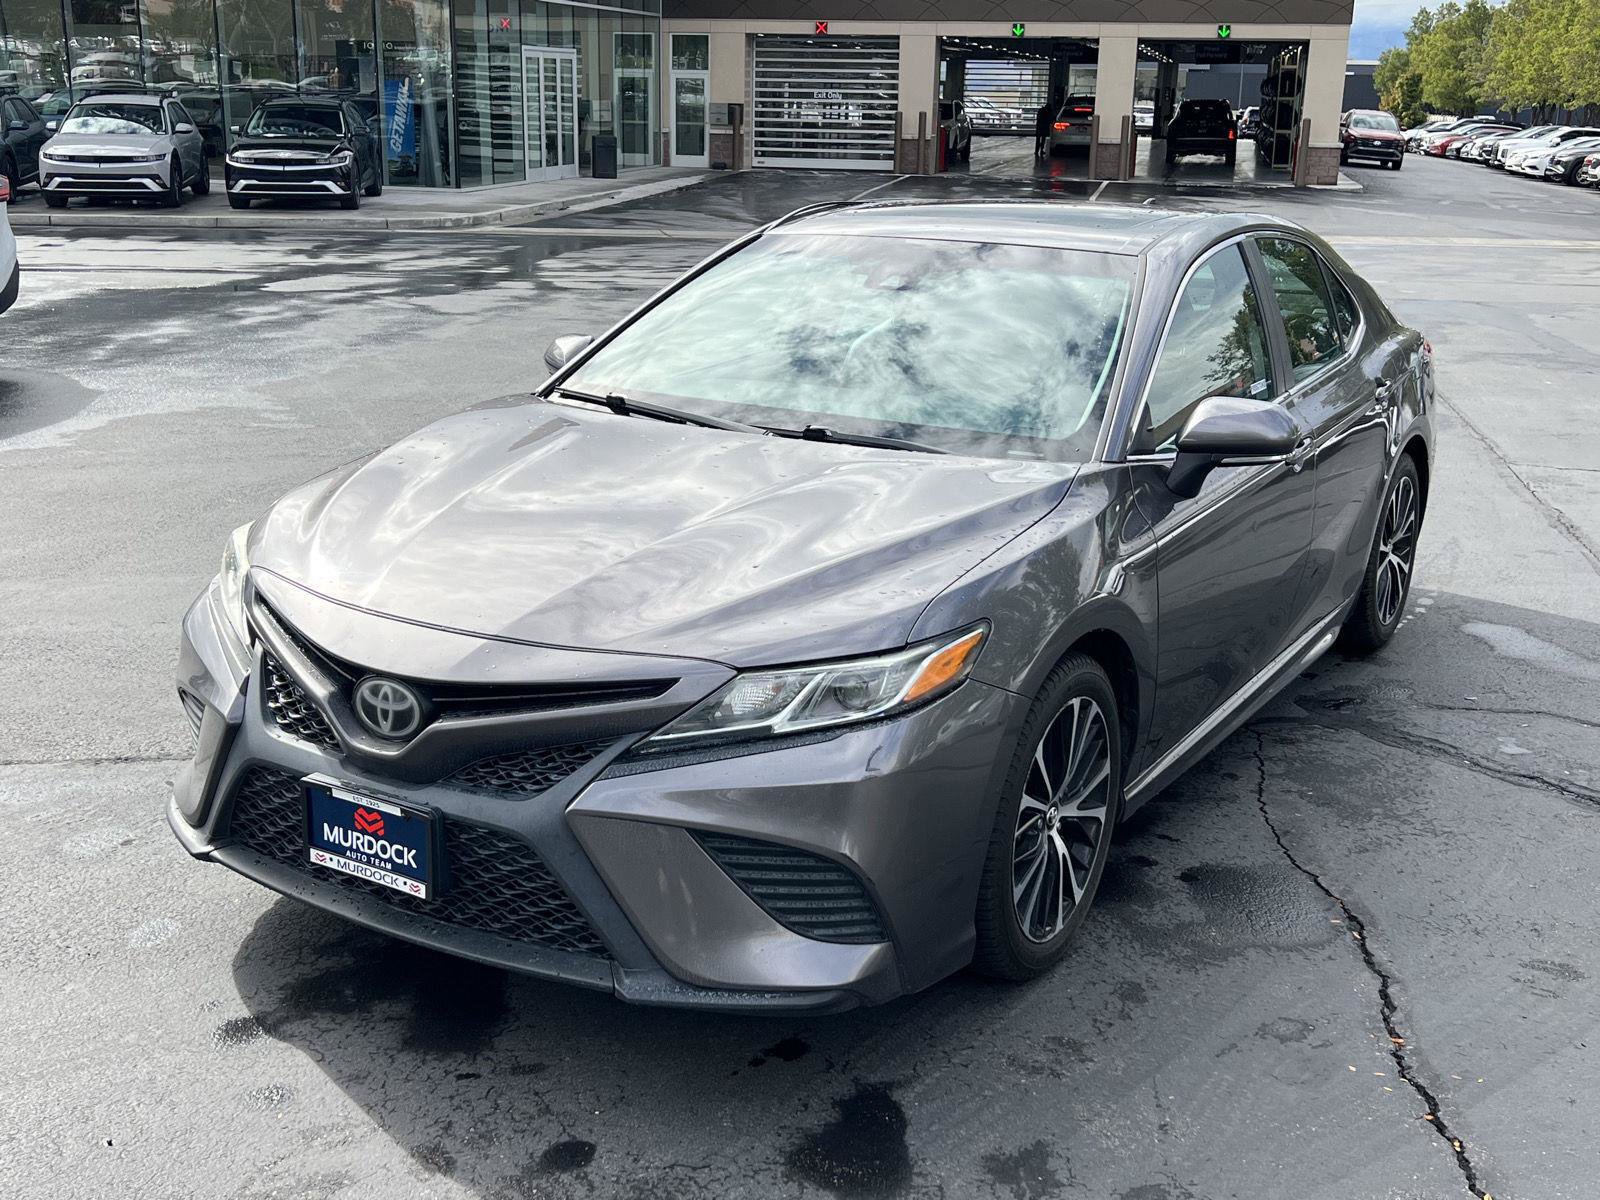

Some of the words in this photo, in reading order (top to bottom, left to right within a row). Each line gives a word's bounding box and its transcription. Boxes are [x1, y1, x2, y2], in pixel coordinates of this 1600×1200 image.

[814, 91, 826, 99] Exit
[828, 91, 842, 100] Only
[323, 822, 418, 869] MURDOCK
[345, 849, 368, 863] AUTO
[370, 856, 392, 870] TEAM
[336, 858, 400, 887] MURDOCK
